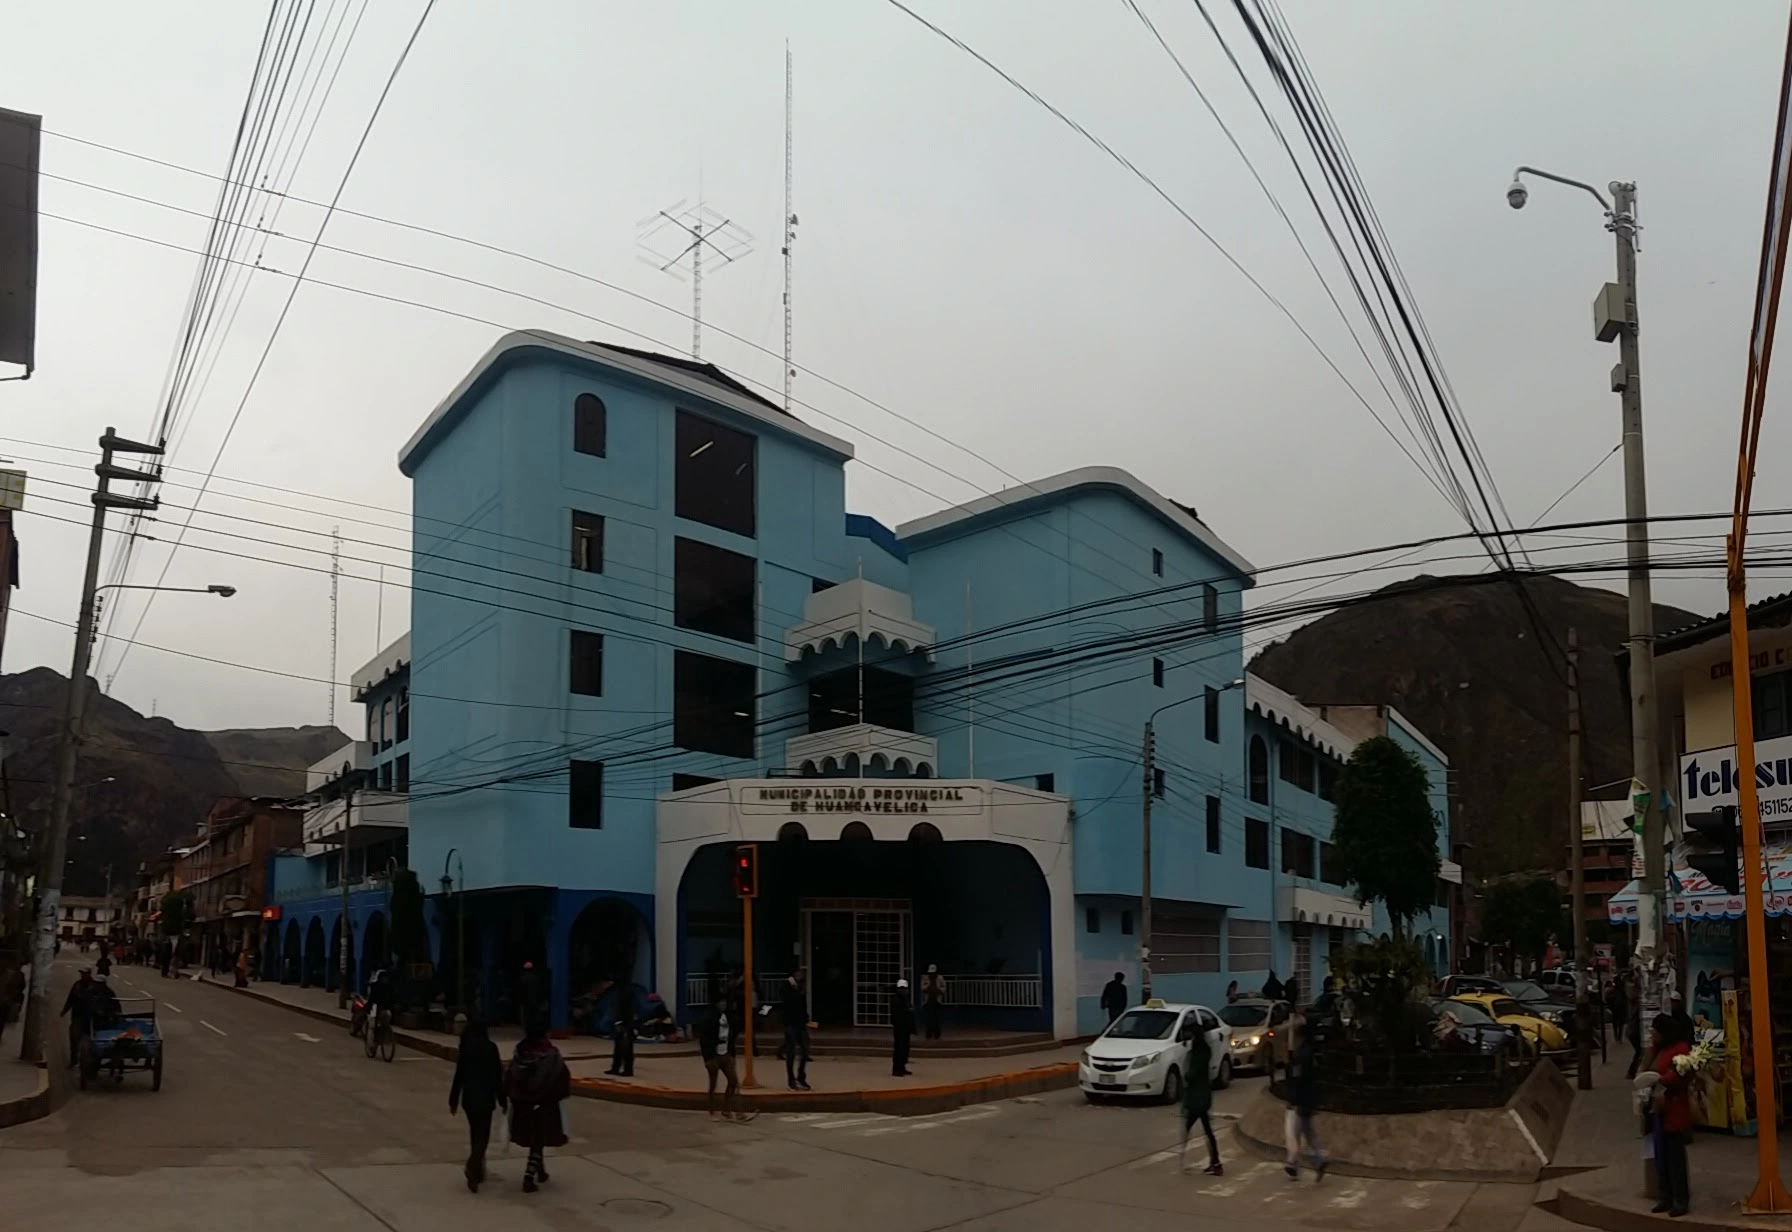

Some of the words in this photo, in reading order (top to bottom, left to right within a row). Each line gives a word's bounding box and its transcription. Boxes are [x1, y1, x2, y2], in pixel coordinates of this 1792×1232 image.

[1711, 651, 1768, 680] EDICIO
[760, 788, 866, 800] MUNICIPALIDAD
[873, 788, 963, 801] PROVINCIAL
[791, 801, 808, 812] DE
[815, 801, 928, 813] HUANCAVELICA
